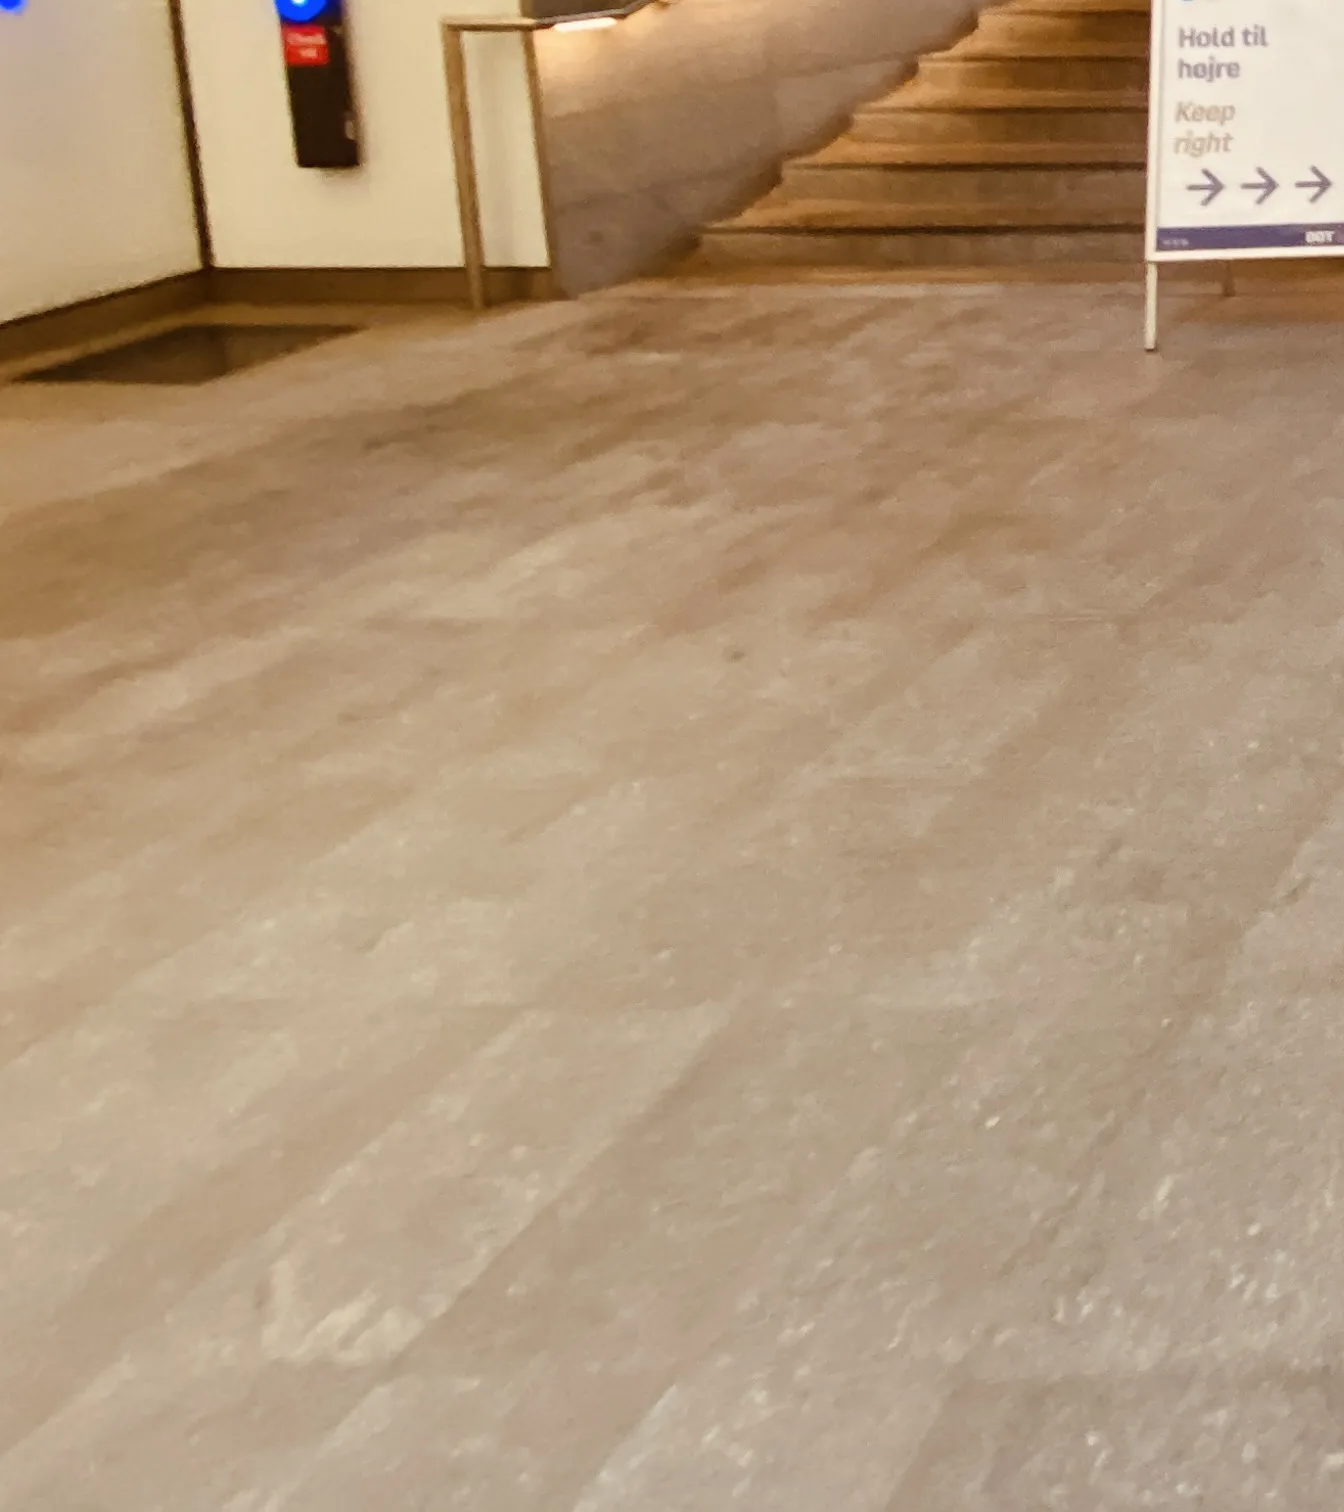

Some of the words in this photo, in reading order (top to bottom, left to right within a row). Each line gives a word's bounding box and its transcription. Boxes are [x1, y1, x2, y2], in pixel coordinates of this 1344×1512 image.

[1177, 26, 1235, 49] Hold
[1242, 24, 1269, 47] til
[1177, 57, 1241, 83] højre
[1174, 101, 1236, 126] Keep
[1173, 131, 1234, 158] right
